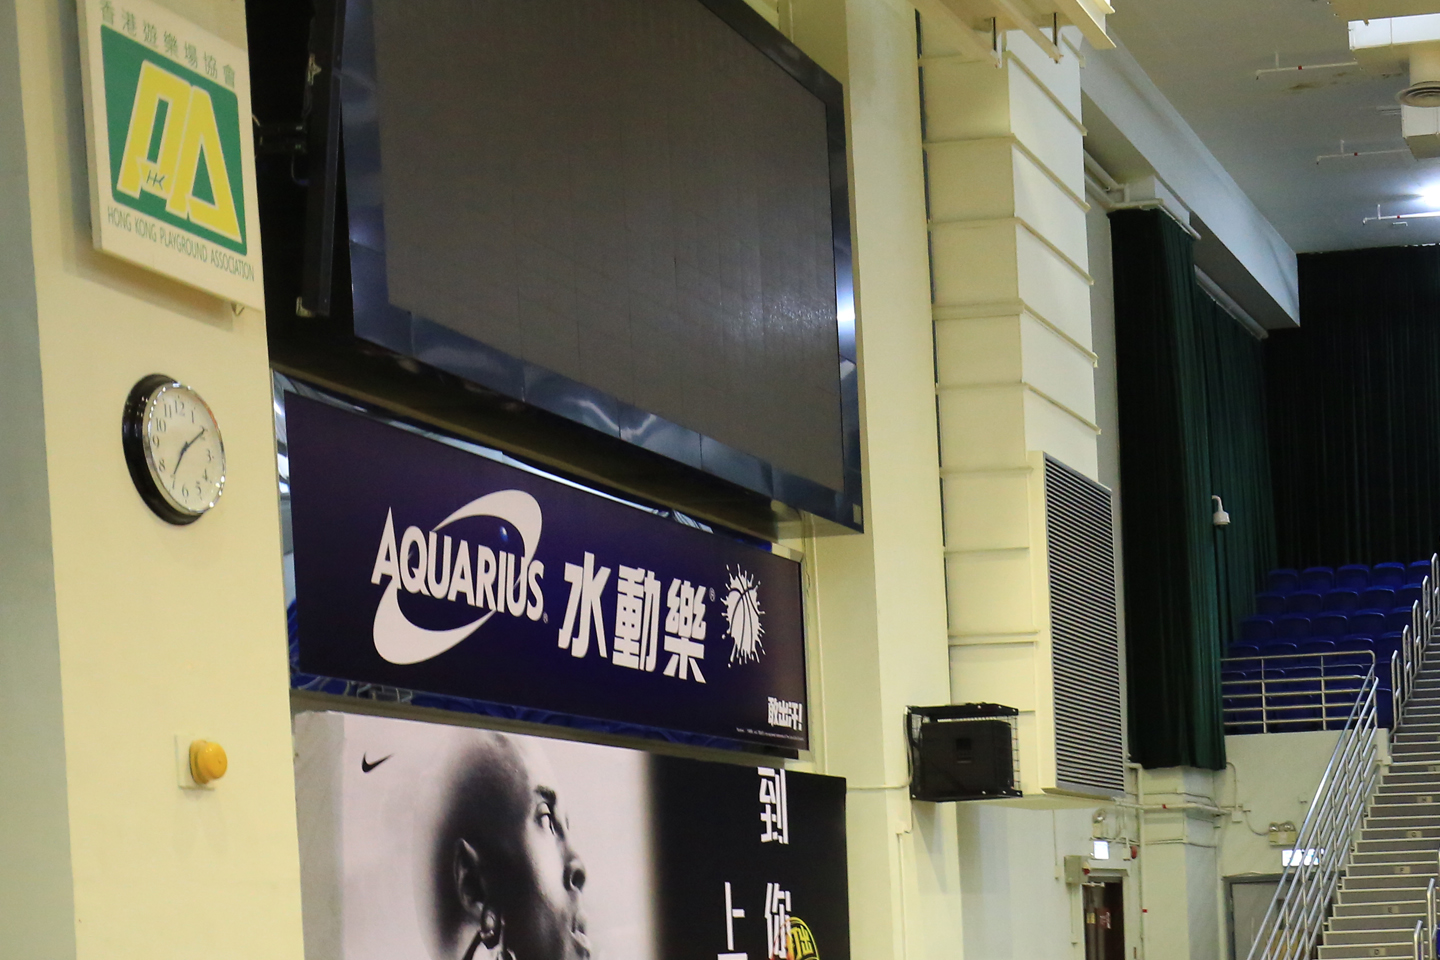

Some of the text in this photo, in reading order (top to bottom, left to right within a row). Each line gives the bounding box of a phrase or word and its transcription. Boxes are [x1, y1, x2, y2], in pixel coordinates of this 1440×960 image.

[107, 206, 255, 282] HONG KONG PLAYGROUND ASSOCIATION
[371, 506, 544, 622] AQUARIUS
[557, 551, 706, 684] 水動樂
[767, 696, 802, 732] 敢出汗!
[757, 767, 792, 960] 到你
